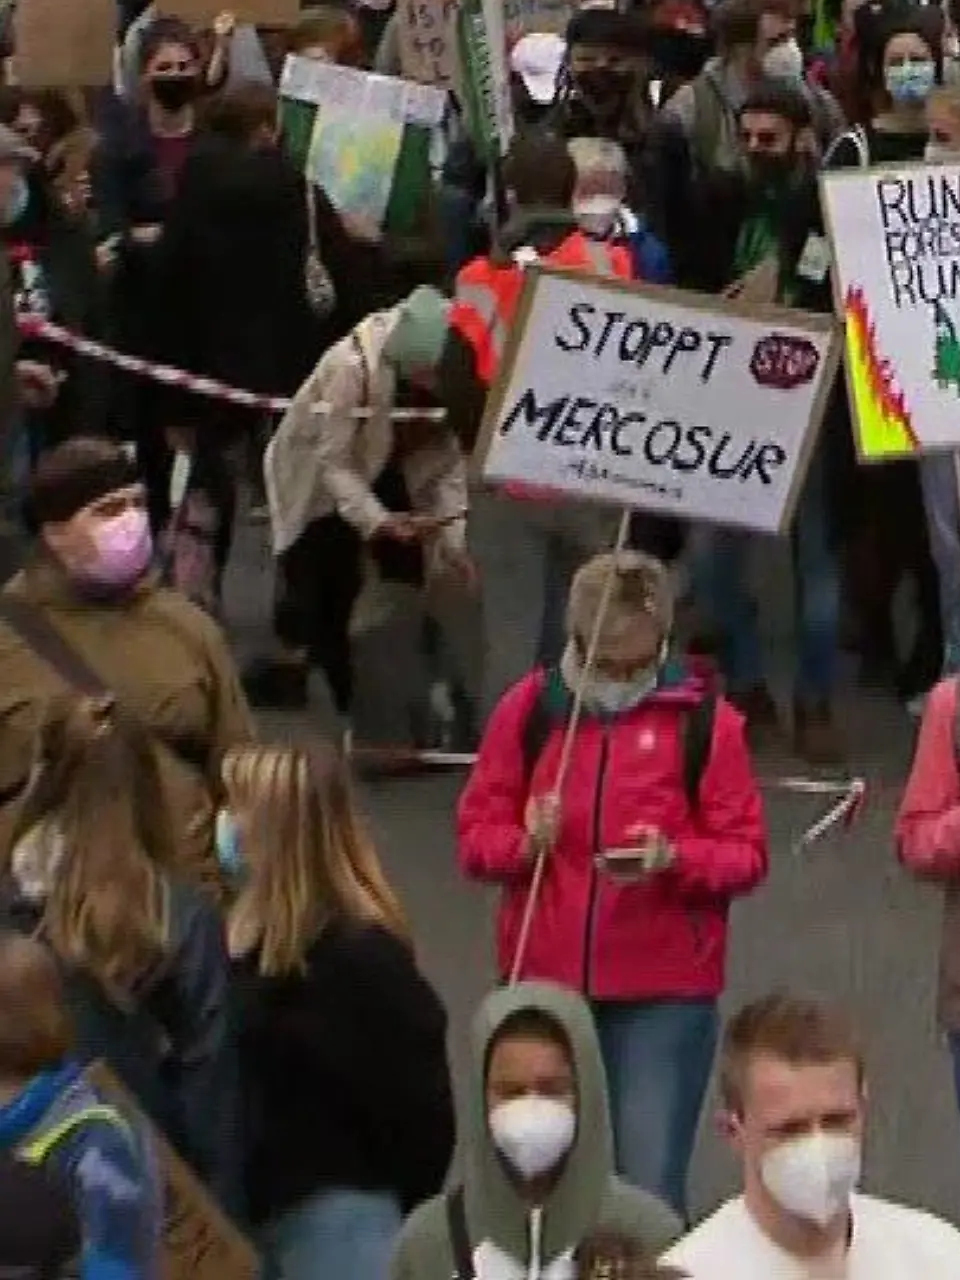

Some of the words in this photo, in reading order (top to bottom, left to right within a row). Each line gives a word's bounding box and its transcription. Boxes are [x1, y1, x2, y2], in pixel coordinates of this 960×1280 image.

[554, 303, 733, 385] STOPPT
[753, 337, 819, 379] STOP
[499, 387, 788, 485] MERCOSUR
